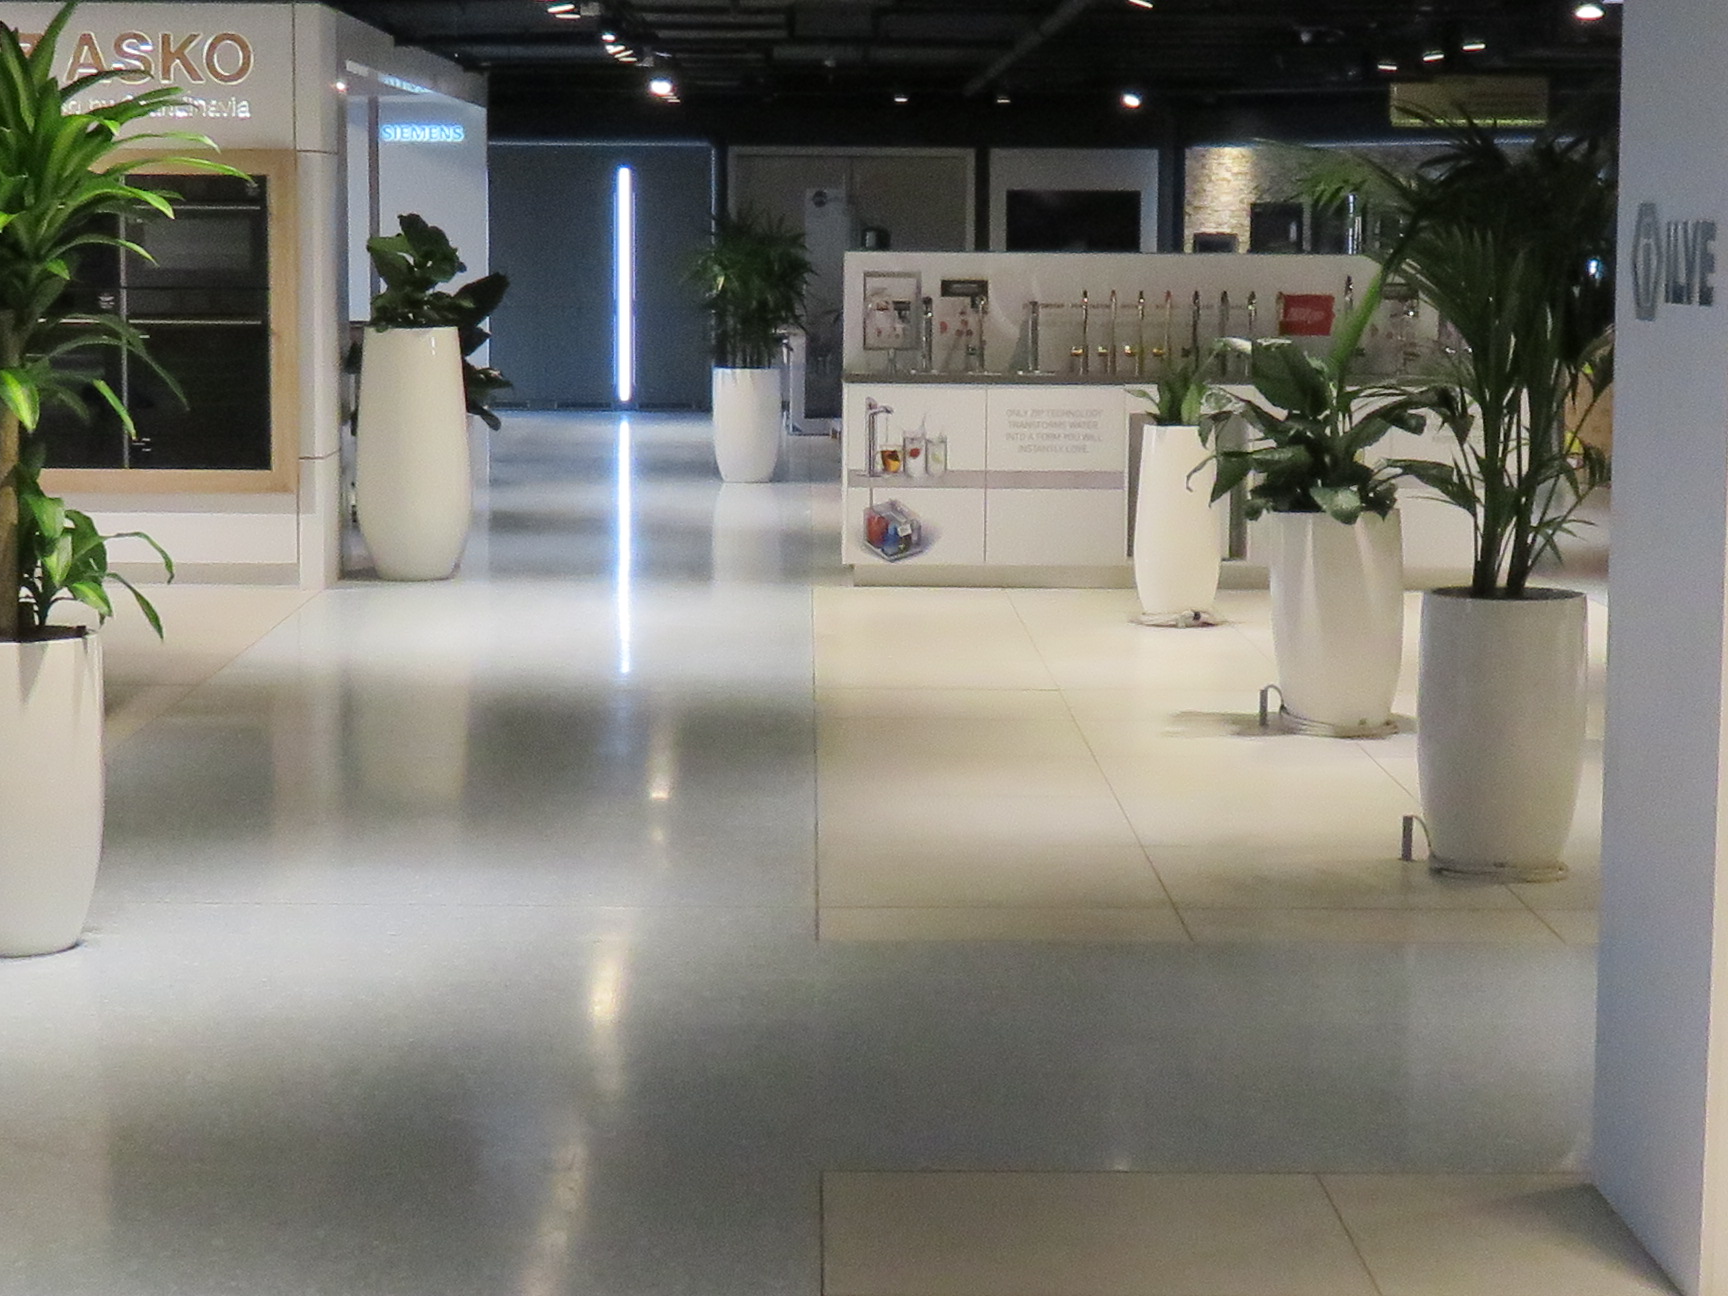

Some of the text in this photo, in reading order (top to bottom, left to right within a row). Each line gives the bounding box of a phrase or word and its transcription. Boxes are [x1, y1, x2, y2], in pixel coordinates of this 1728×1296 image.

[65, 30, 255, 86] ASKO
[380, 123, 465, 142] SIEMENS
[1664, 220, 1717, 307] ILVE
